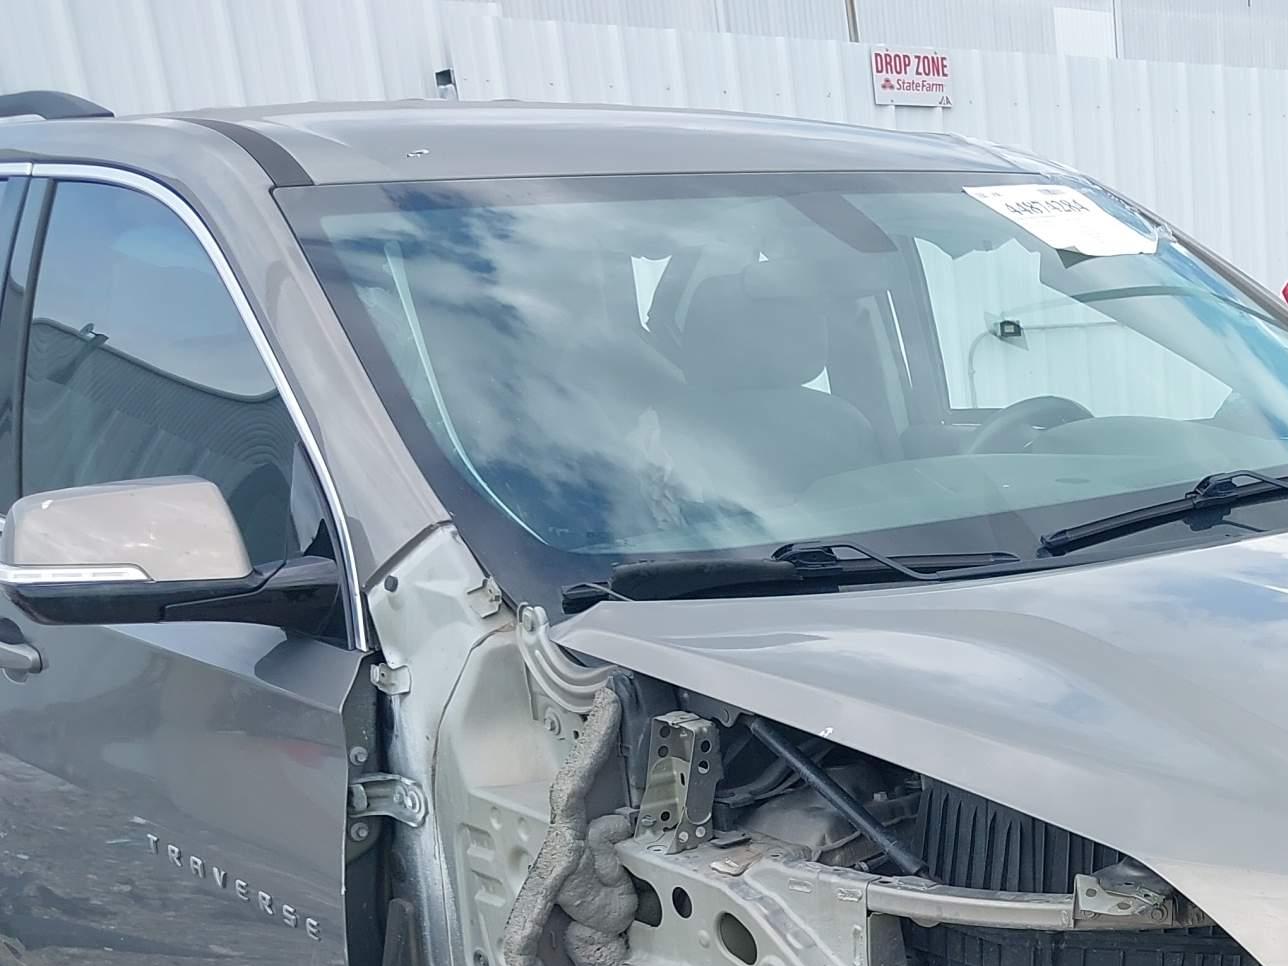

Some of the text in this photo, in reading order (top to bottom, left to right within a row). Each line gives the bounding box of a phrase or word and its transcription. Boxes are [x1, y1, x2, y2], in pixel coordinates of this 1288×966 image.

[874, 52, 949, 77] DROP ZONE
[146, 833, 322, 943] TRAVERSE
